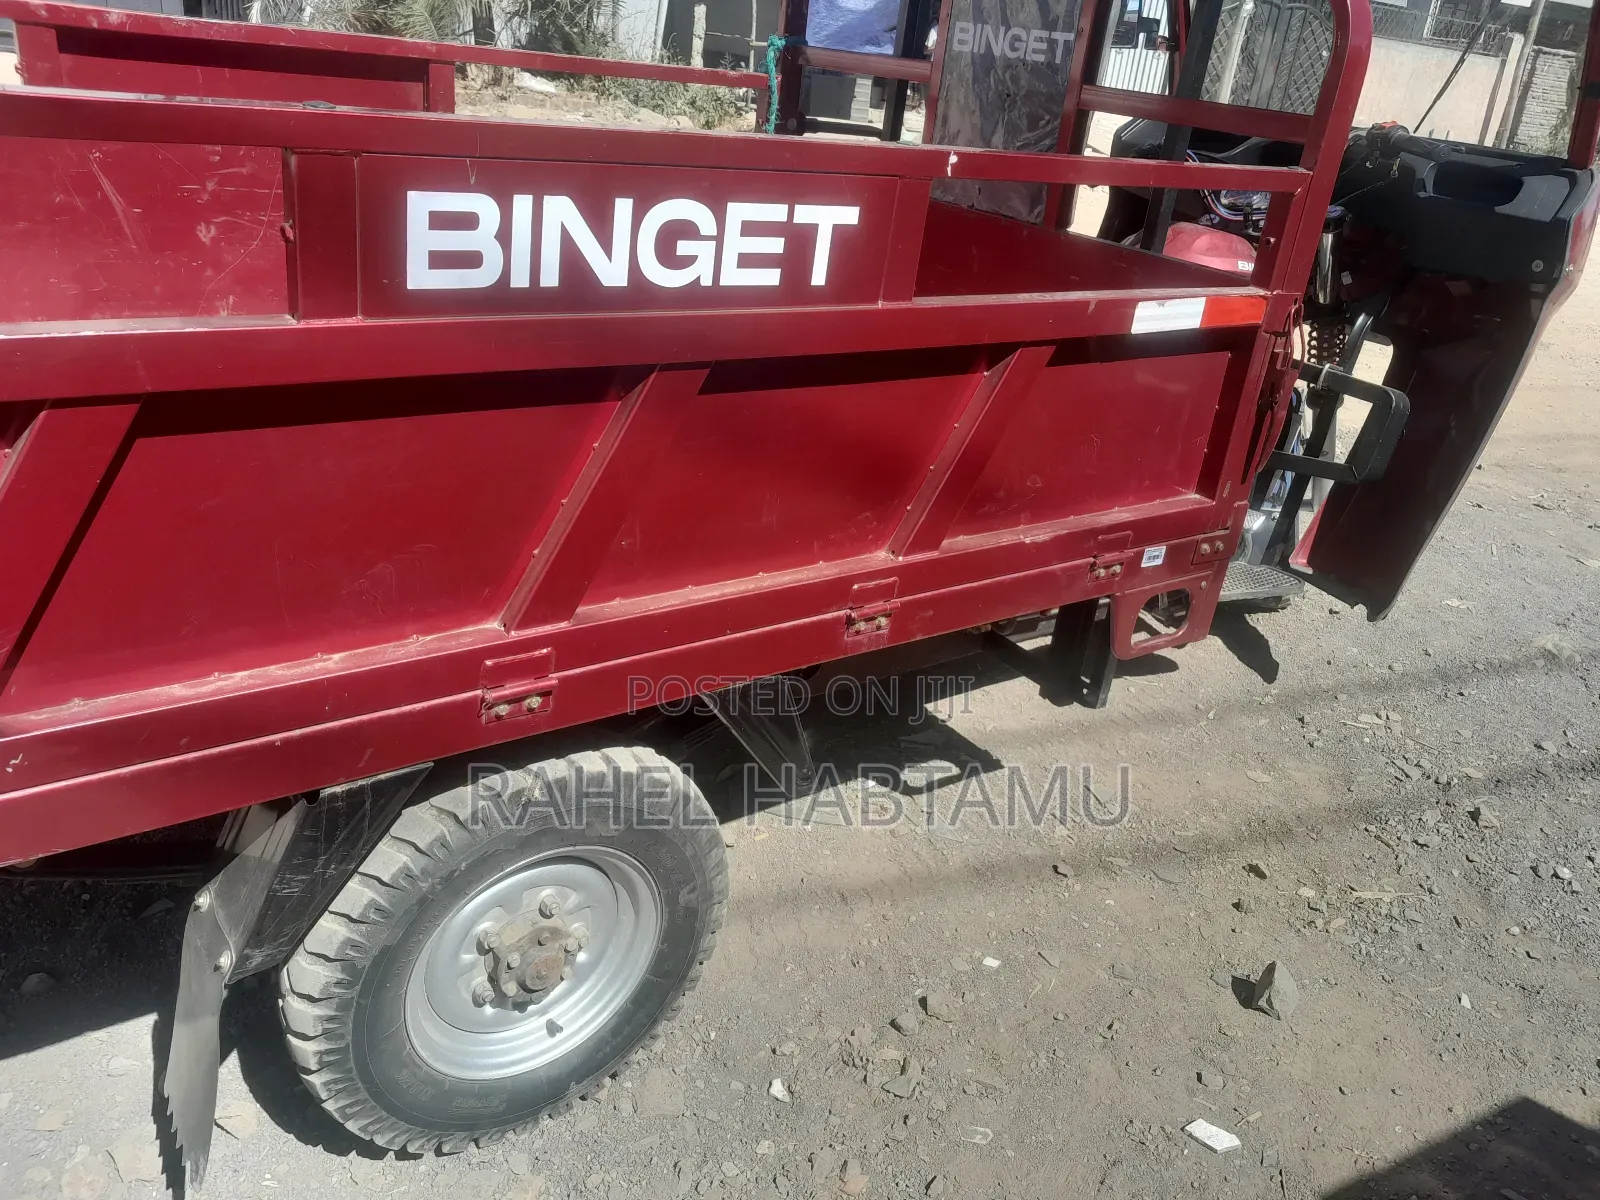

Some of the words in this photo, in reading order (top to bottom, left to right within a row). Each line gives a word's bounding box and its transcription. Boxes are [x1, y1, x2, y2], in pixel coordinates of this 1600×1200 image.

[952, 21, 1075, 64] BINGET
[406, 190, 861, 290] BINGET
[1237, 260, 1255, 272] BI
